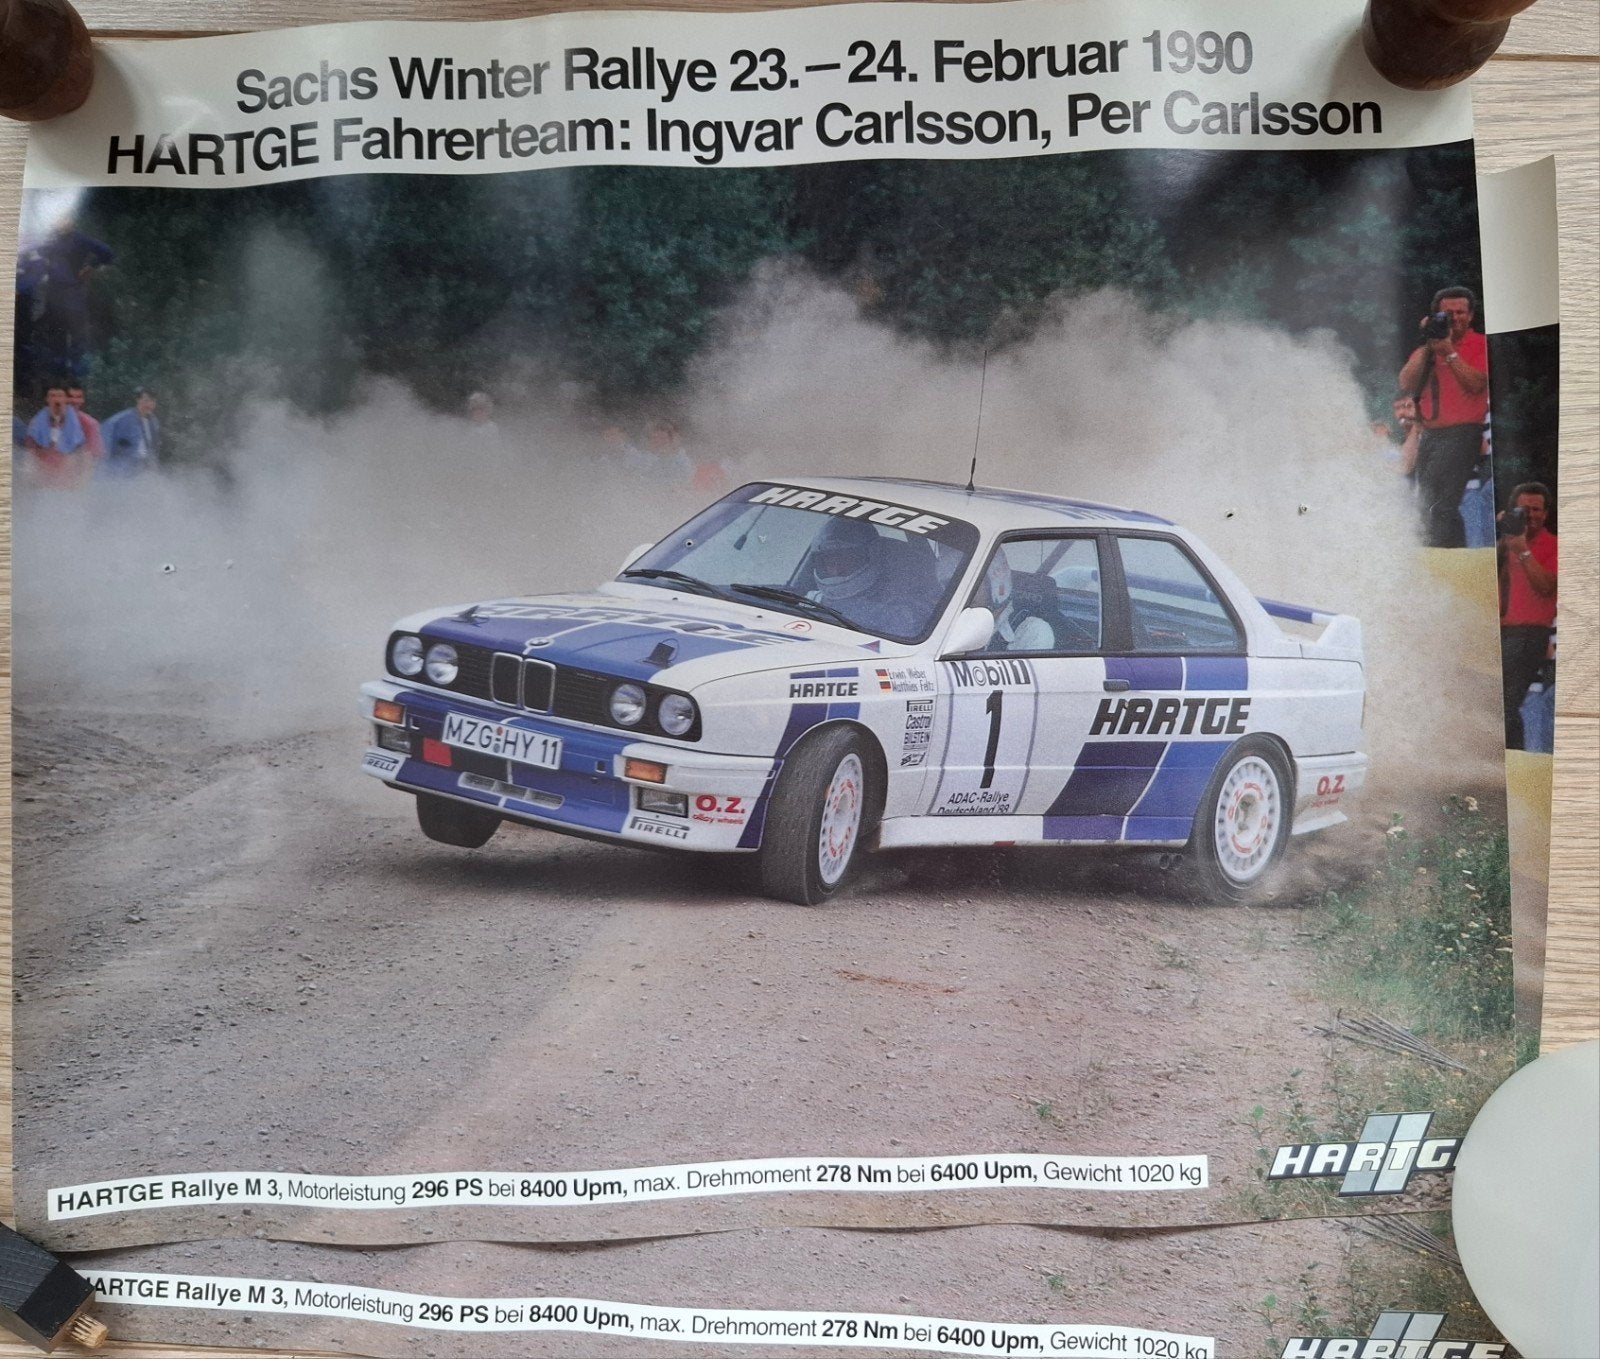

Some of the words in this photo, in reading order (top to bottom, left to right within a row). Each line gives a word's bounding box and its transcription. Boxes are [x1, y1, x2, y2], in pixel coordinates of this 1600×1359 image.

[235, 60, 379, 114] Sachs
[388, 56, 552, 101] Winter
[564, 46, 717, 103] Rallye
[934, 39, 1128, 83] Februar
[1143, 30, 1253, 75] 1990
[108, 121, 319, 176] HARTGE
[334, 116, 631, 162] Fahrerteam:
[647, 108, 803, 166] Ingvar
[816, 100, 1051, 149] Carlsson,
[1068, 92, 1150, 138] Per
[1163, 91, 1382, 136] Carlsson
[749, 487, 950, 534] HARTGE
[950, 660, 1011, 687] Mobil
[789, 682, 859, 699] HARTGE
[906, 699, 934, 712] PIRELLI
[905, 713, 933, 729] Castrol
[1089, 698, 1251, 735] HARTGE
[540, 738, 558, 766] 11
[980, 690, 1004, 789] 1
[696, 794, 746, 814] O.Z.
[947, 791, 1010, 805] ADAC-Rallye
[629, 816, 691, 840] PIRELLI
[1269, 1139, 1457, 1176] HARTG
[58, 1183, 163, 1212] HARTGE
[172, 1179, 238, 1201] Rallye
[246, 1179, 261, 1196] M
[268, 1179, 282, 1199] 3,
[289, 1180, 405, 1205] Motorleistung
[412, 1180, 448, 1198] 296
[456, 1178, 483, 1196] PS
[489, 1179, 514, 1196] bei
[521, 1180, 567, 1197] 8400
[574, 1179, 627, 1200] Upm,
[635, 1177, 679, 1192] max.
[688, 1165, 811, 1189] Drehmoment
[817, 1165, 851, 1182] 278
[858, 1165, 891, 1182] Nm
[898, 1164, 924, 1183] bei
[931, 1162, 978, 1181] 6400
[985, 1161, 1038, 1183] Upm,
[1044, 1162, 1122, 1182] Gewicht
[1129, 1164, 1174, 1182] 1020
[1180, 1163, 1201, 1185] kg
[87, 1278, 169, 1298] ARTGE
[177, 1281, 241, 1306] Rallye
[248, 1286, 265, 1303] M
[272, 1288, 287, 1308] 3,
[295, 1288, 413, 1322] Motorleistung
[419, 1303, 453, 1322] 296
[460, 1305, 488, 1323] PS
[495, 1306, 523, 1323] bei
[529, 1305, 577, 1323] 8400
[584, 1306, 634, 1331] Upm,
[641, 1316, 685, 1332] max.
[693, 1316, 817, 1337] Drehmoment
[822, 1320, 857, 1338] 278
[864, 1321, 897, 1339] Nm
[904, 1322, 931, 1341] bei
[938, 1326, 985, 1347] 6400
[992, 1330, 1043, 1354] Upm,
[1051, 1331, 1127, 1352] Gewicht
[1134, 1337, 1179, 1358] 1020
